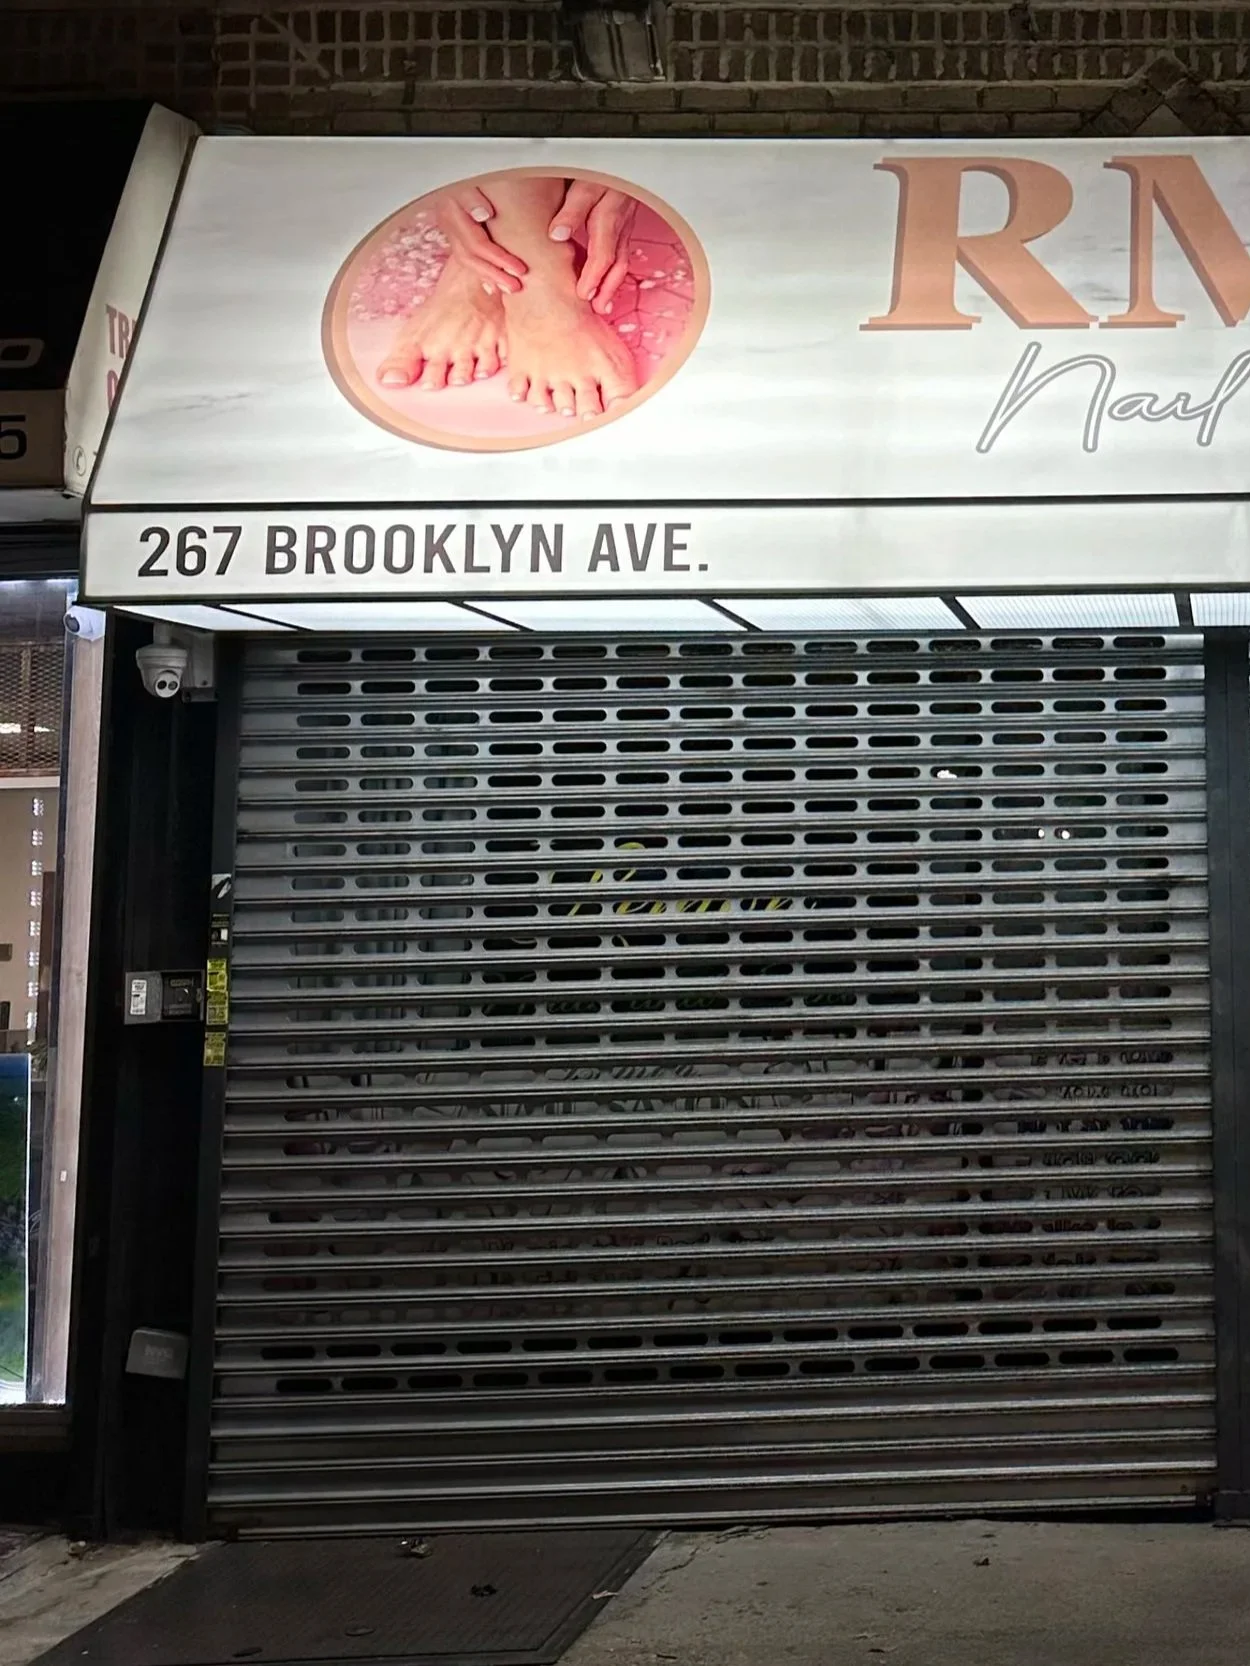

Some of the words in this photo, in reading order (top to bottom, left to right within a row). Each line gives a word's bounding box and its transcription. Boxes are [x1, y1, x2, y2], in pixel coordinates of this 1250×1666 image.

[137, 525, 243, 577] 267
[265, 524, 564, 575] BROOKLYN
[588, 523, 710, 572] AVE.
